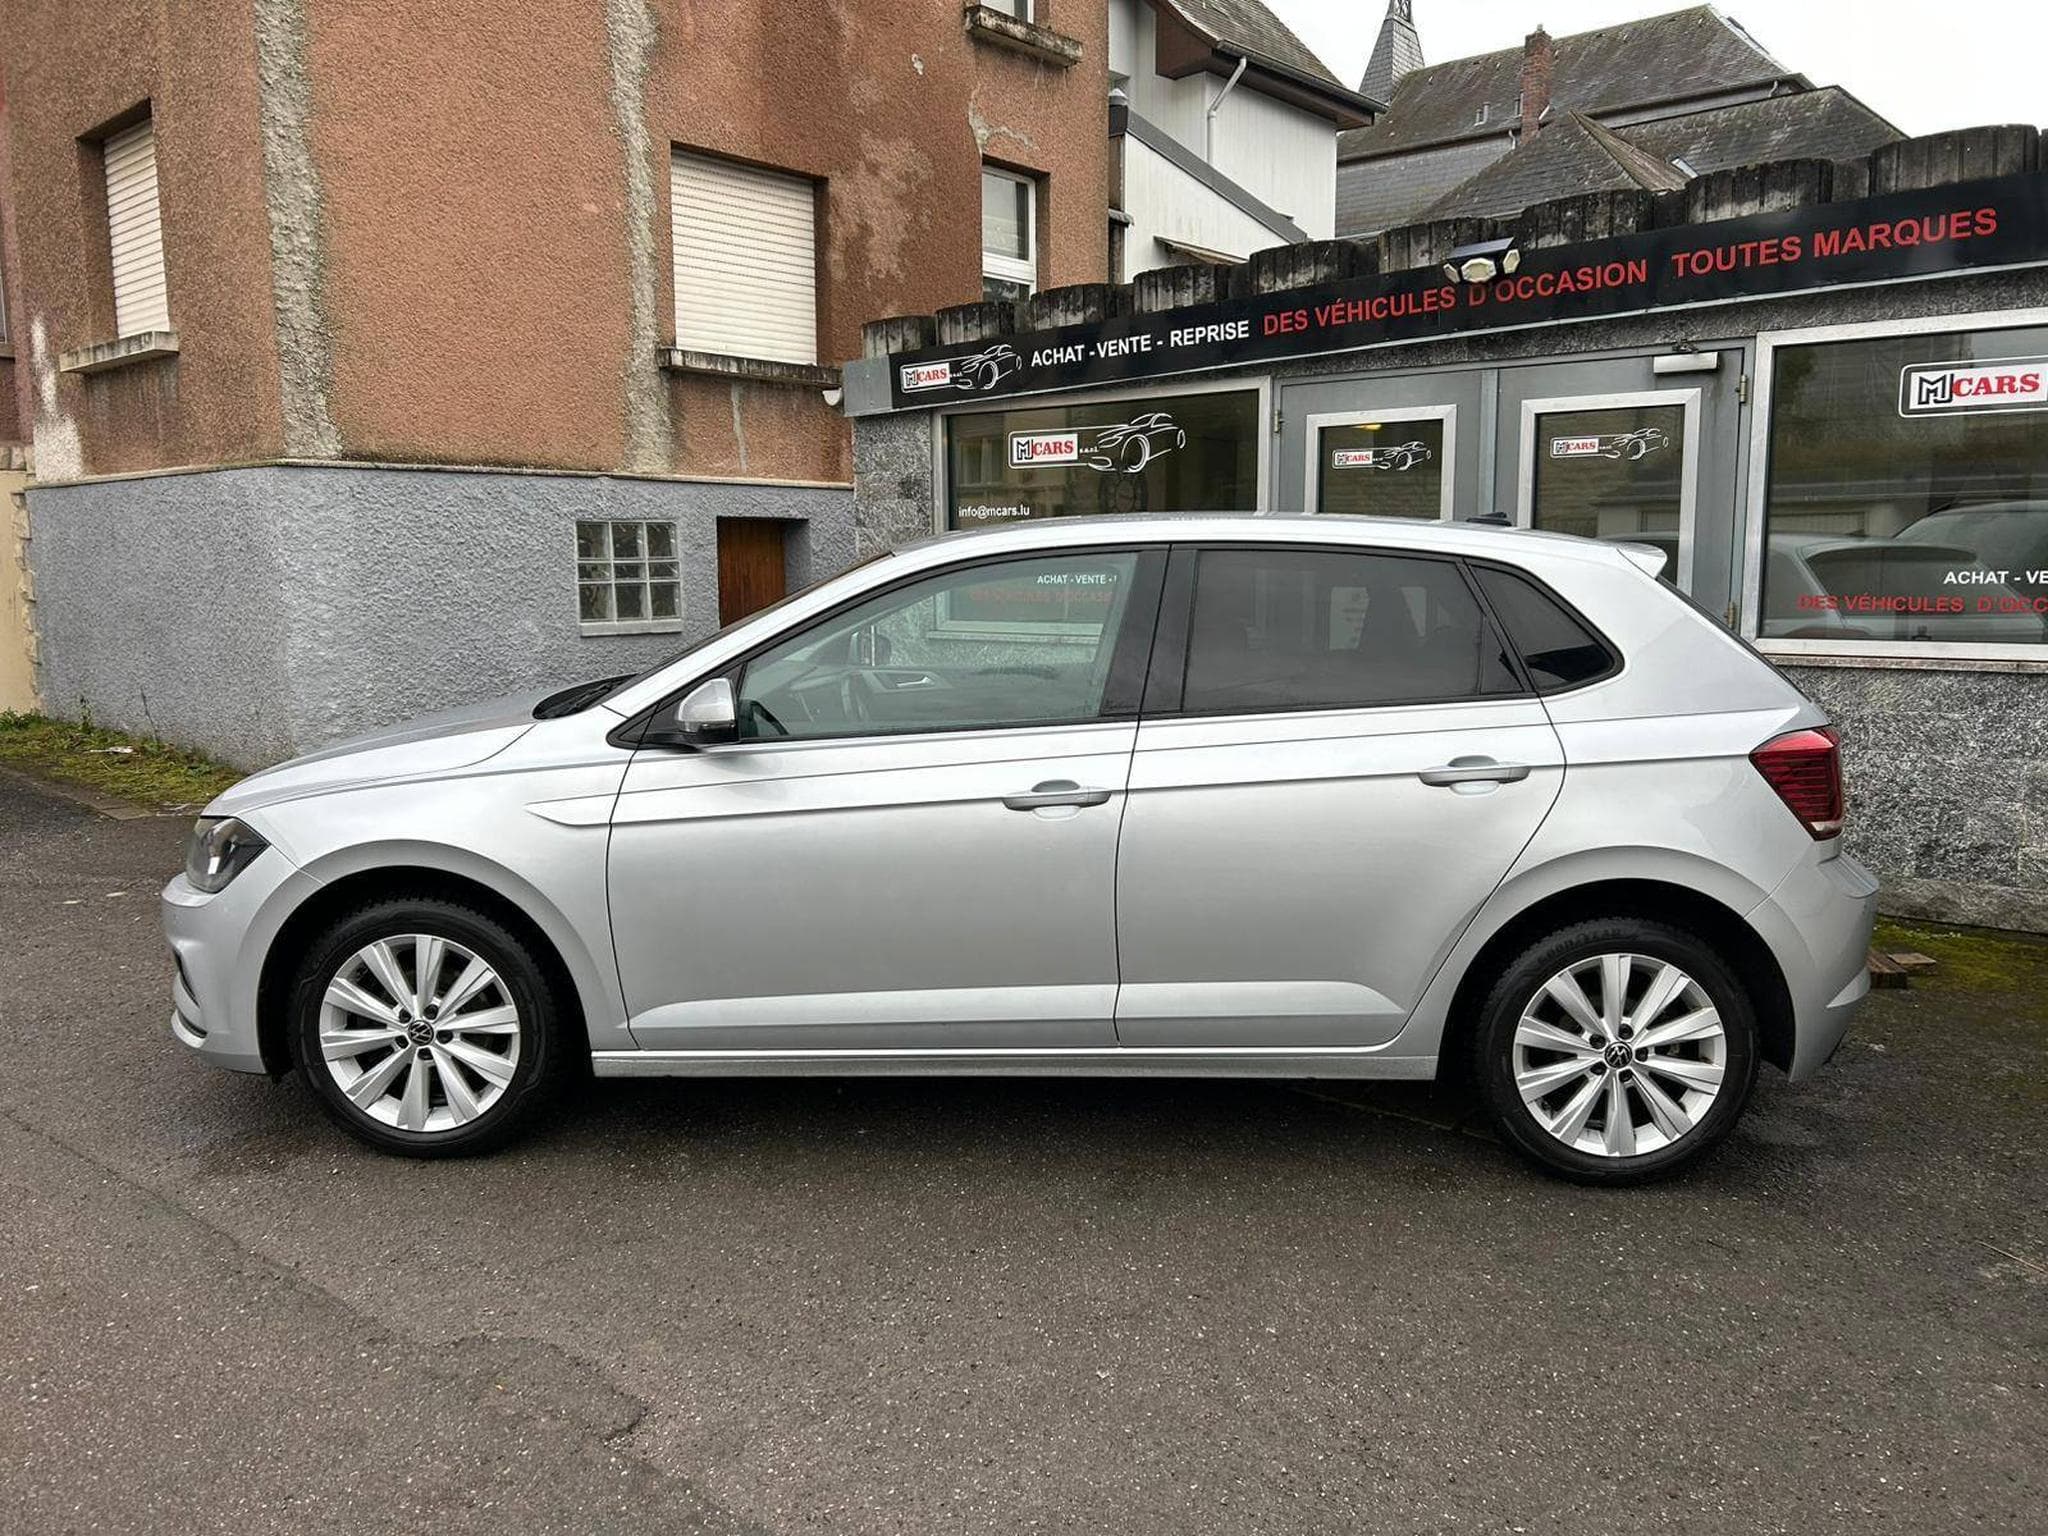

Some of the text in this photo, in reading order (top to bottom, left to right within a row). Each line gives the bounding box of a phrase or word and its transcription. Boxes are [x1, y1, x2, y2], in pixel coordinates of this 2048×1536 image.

[1031, 345, 1085, 368] ACHAT
[1096, 334, 1151, 359] VENTE
[1170, 319, 1249, 348] REPRISE
[1264, 310, 1308, 336] DES
[1315, 286, 1455, 327] VÉHICULES
[1672, 236, 1802, 278] TOUTES
[1813, 207, 1998, 258] MARQUES
[958, 504, 1030, 519] info@mcars.lu
[1037, 575, 1067, 584] ACHAT
[1075, 575, 1106, 584] VENTE
[1944, 571, 2009, 584] ACHAT
[1796, 595, 1839, 610] DES
[1845, 592, 1964, 612] VÉHICULES
